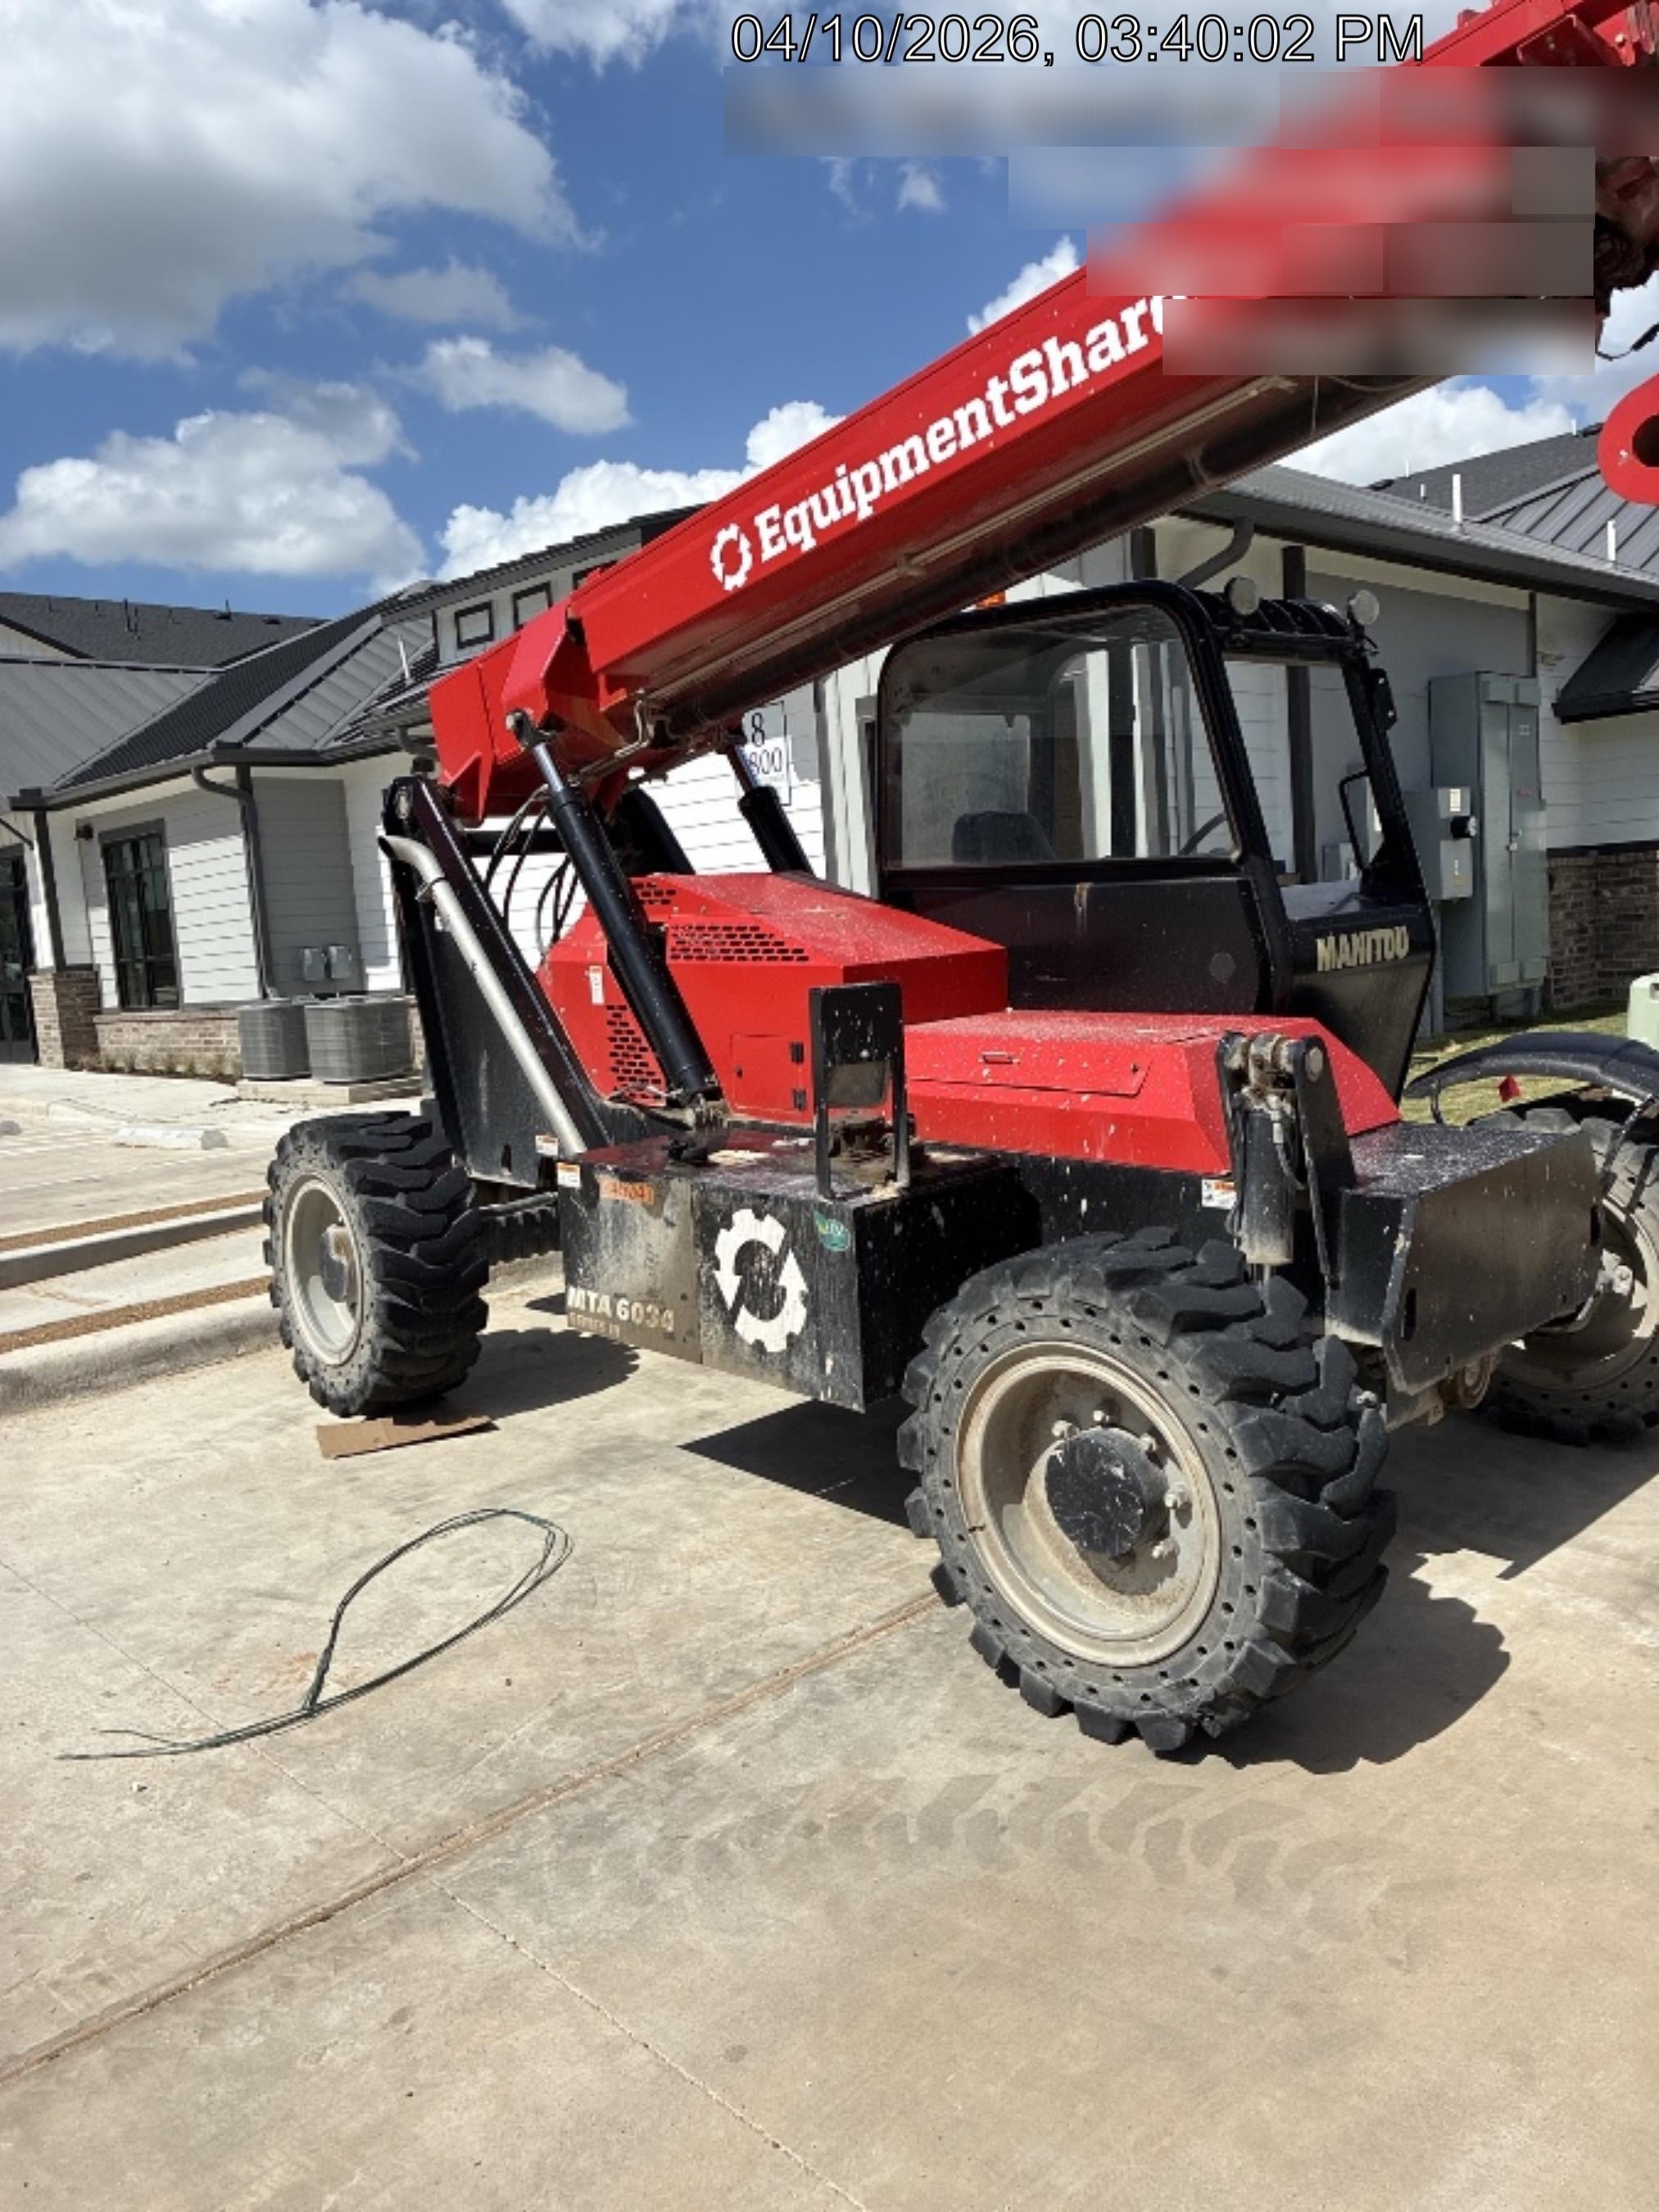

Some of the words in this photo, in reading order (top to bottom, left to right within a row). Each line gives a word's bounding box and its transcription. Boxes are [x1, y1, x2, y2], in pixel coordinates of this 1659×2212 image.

[751, 711, 765, 747] 8
[1316, 925, 1410, 972] MANITOU
[566, 1284, 613, 1318] MTA
